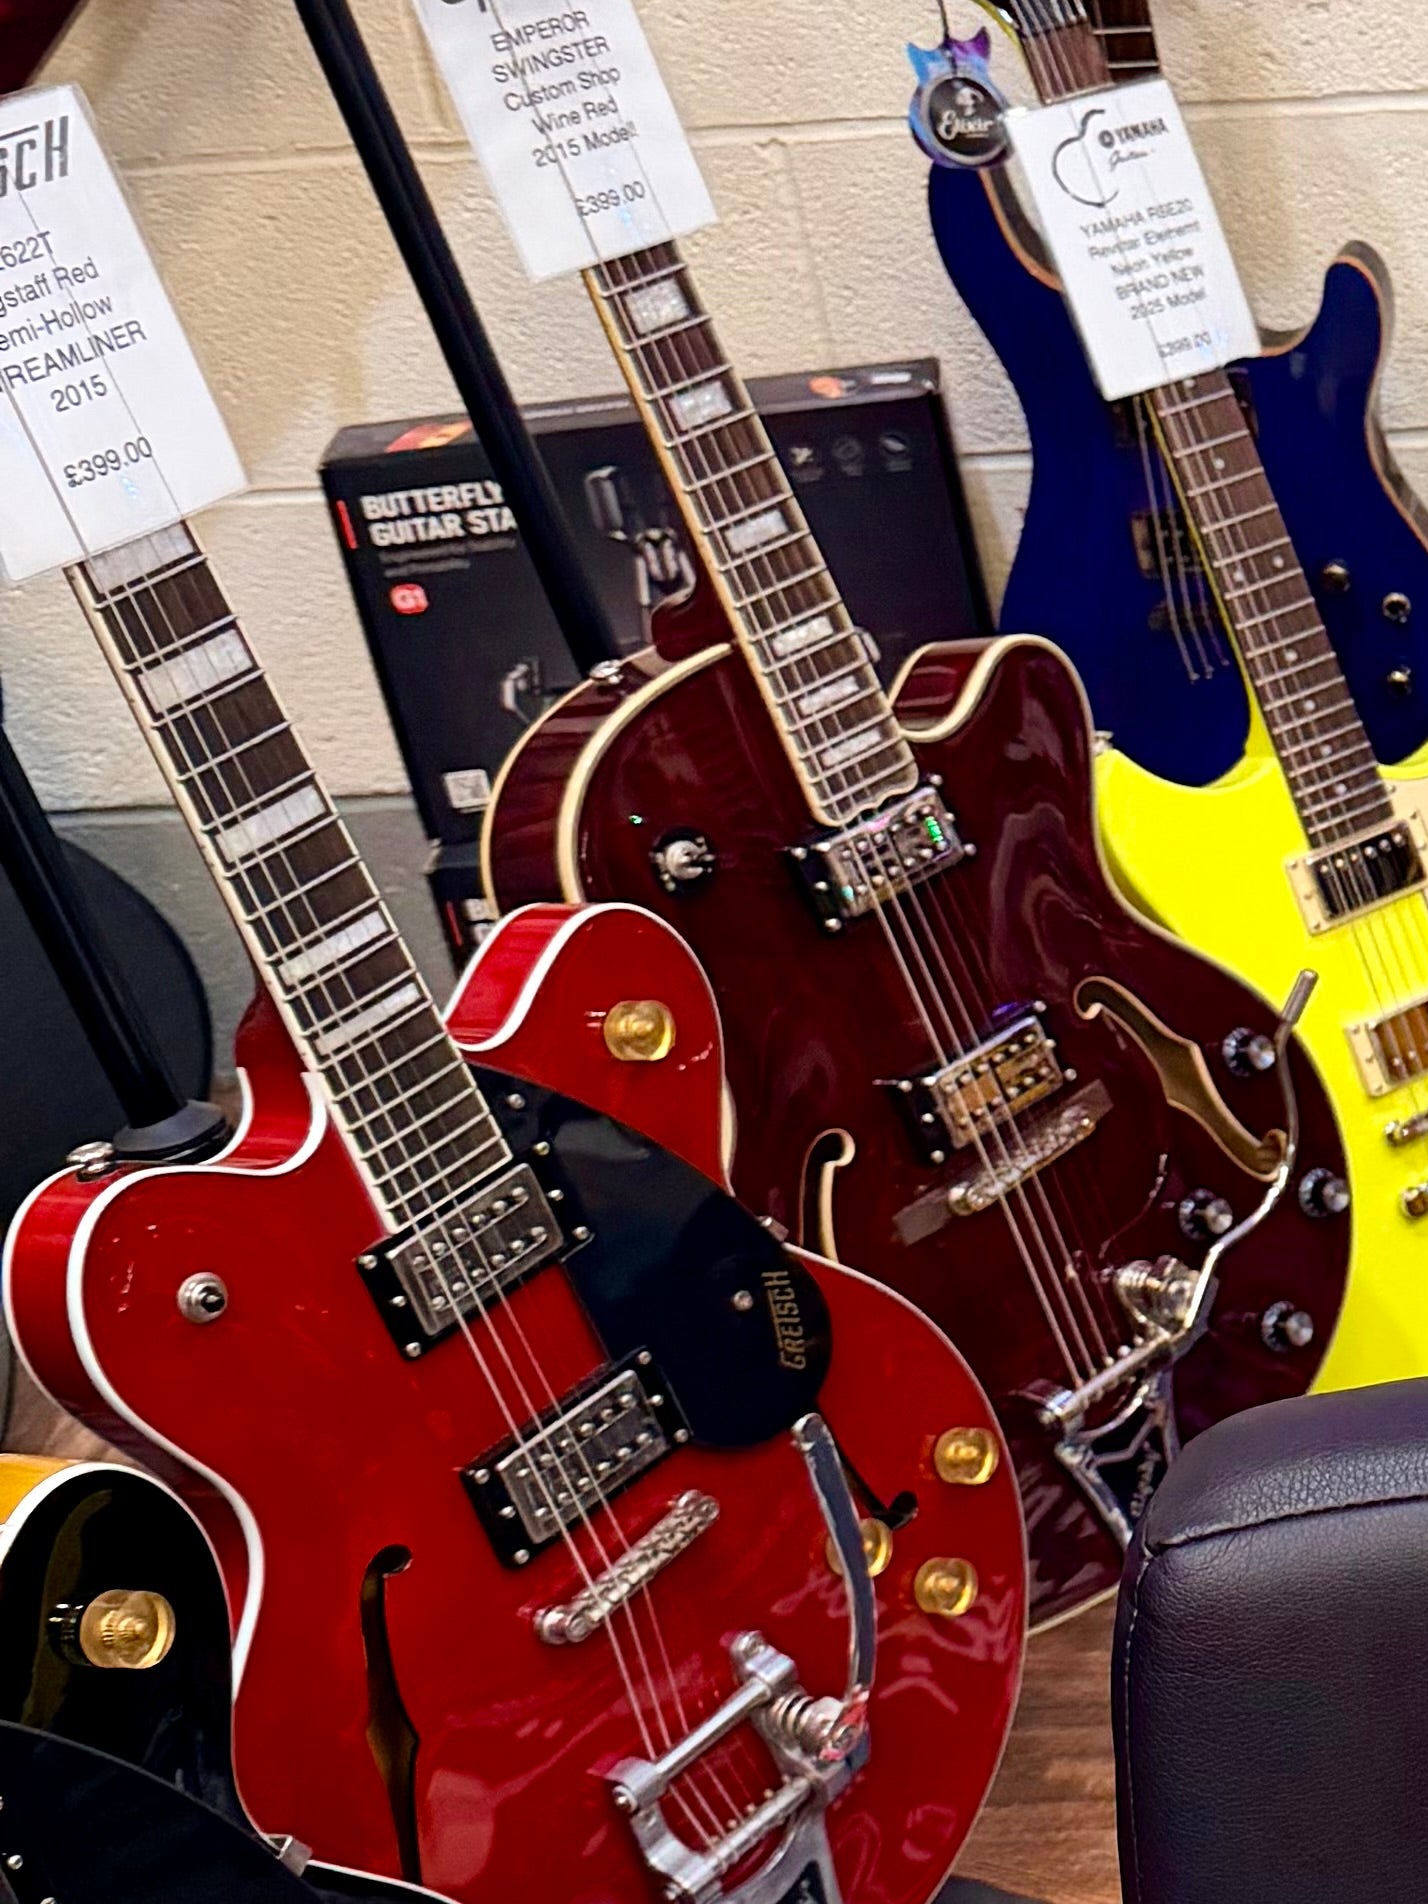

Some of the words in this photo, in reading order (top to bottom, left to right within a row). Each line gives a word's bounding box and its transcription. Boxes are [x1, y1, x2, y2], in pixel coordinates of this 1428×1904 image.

[491, 10, 590, 52] EMPEROR
[492, 36, 611, 84] SWINGSTER
[503, 74, 577, 112] Custom
[580, 66, 621, 92] Shop
[531, 107, 581, 136] Wine
[584, 97, 619, 122] Red
[1115, 118, 1169, 144] YAMAHA
[531, 138, 581, 168] 2015
[1080, 211, 1145, 238] YAMAHA
[53, 256, 98, 290] Red
[1115, 274, 1169, 300] BRAND
[1172, 266, 1204, 286] NEW
[1167, 288, 1206, 310] Model
[51, 375, 107, 413] 2015
[64, 436, 152, 489] £399.00
[360, 480, 504, 521] BUTTERFLY
[369, 513, 466, 547] GUITAR
[467, 506, 518, 536] STA
[761, 1271, 806, 1370] GRETSCH
